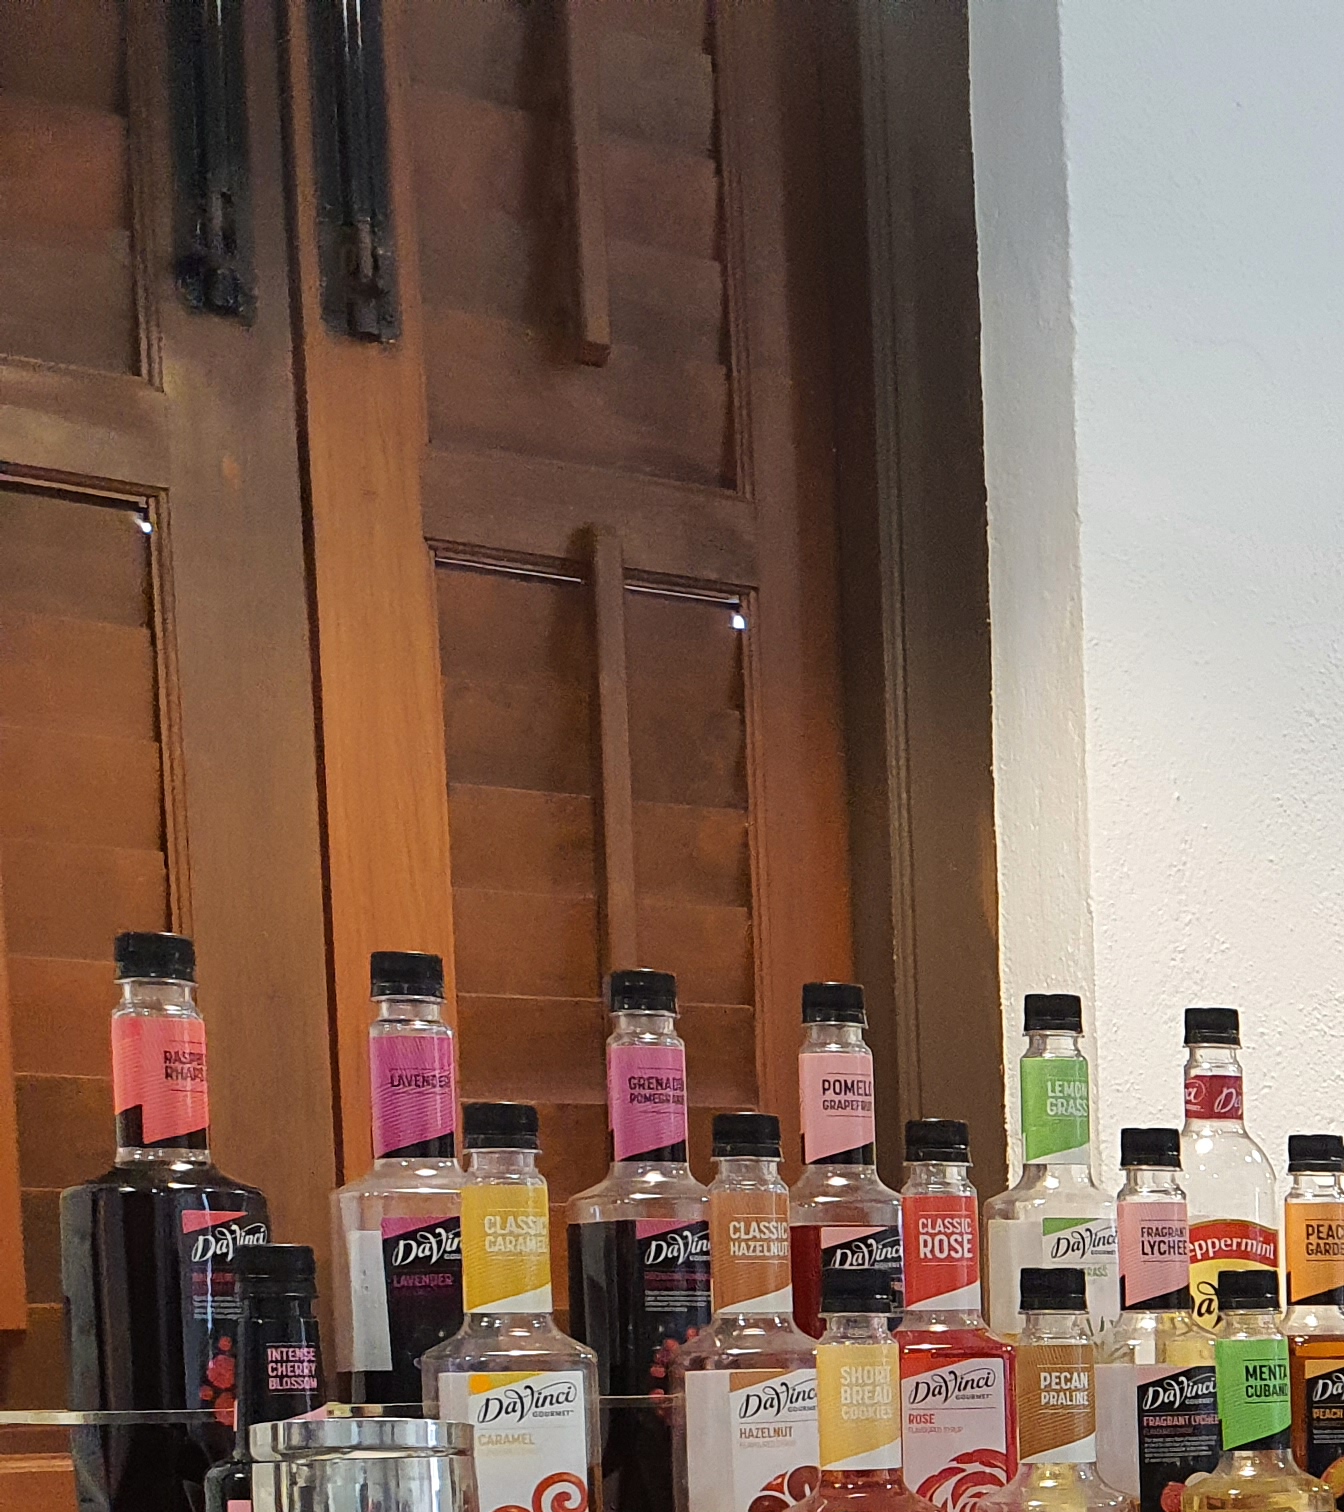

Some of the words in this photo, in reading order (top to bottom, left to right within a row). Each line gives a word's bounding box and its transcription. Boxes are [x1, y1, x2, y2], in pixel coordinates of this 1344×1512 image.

[1047, 1099, 1088, 1116] GRASS
[484, 1216, 546, 1235] CLASSIC
[729, 1222, 788, 1240] CLASSIC
[918, 1218, 972, 1233] CLASSIC
[485, 1236, 548, 1252] CARAMEL
[730, 1242, 788, 1256] HAZELNUT
[919, 1235, 973, 1259] ROSE
[393, 1273, 452, 1287] LAVENDER
[267, 1348, 316, 1361] INTENSE
[267, 1362, 316, 1377] CHERRY
[841, 1365, 892, 1385] SHORT
[268, 1377, 317, 1391] BLOSSOM
[908, 1368, 996, 1405] DaVinci
[1040, 1372, 1088, 1389] PECAN
[841, 1387, 892, 1405] BREAD
[1041, 1391, 1089, 1405] PRALINE
[1143, 1374, 1218, 1410] DaVinci
[477, 1382, 577, 1424] DaVinci
[842, 1406, 893, 1421] COOKIES
[908, 1413, 935, 1425] ROSE
[1143, 1416, 1189, 1427] FRAGRANT
[478, 1433, 535, 1446] CARAMEL
[739, 1427, 794, 1439] HAZELNUT
